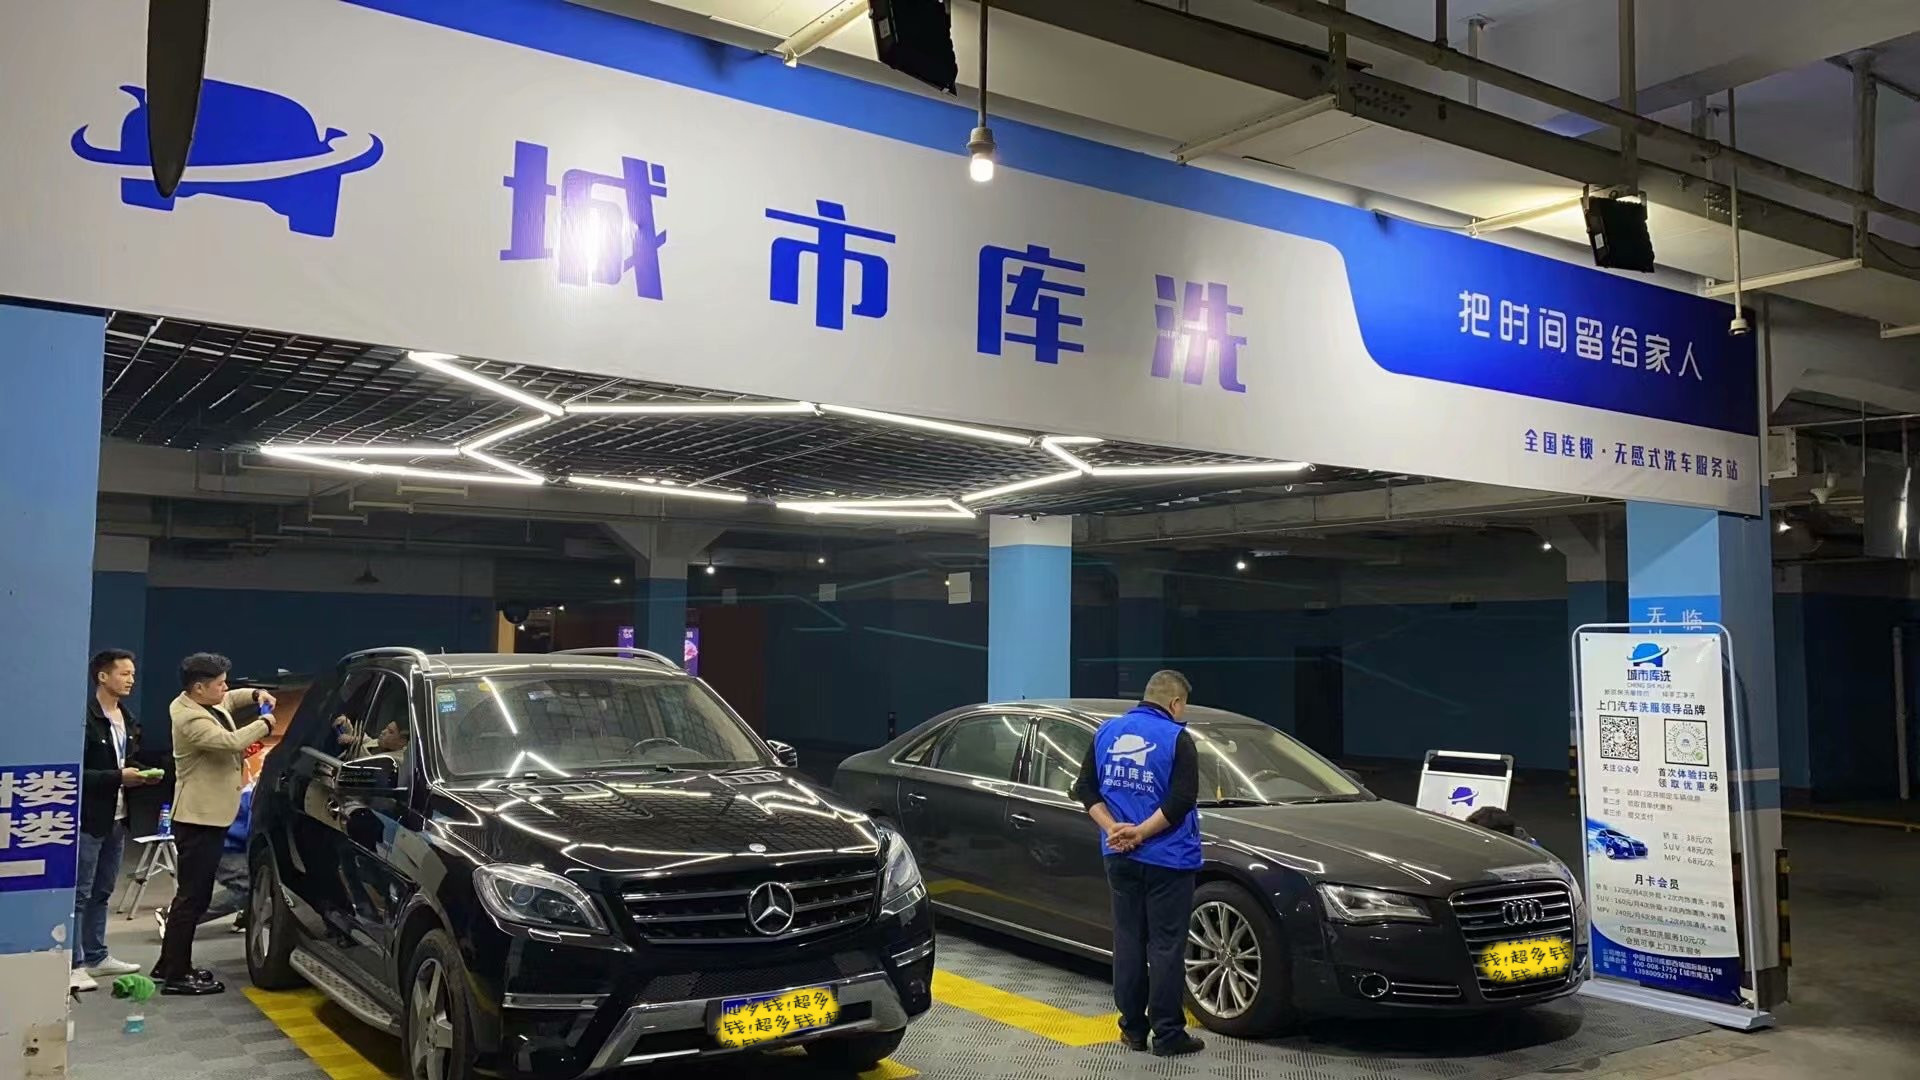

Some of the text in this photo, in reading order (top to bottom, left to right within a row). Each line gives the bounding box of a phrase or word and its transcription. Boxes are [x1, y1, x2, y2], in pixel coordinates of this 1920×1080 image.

[500, 140, 1248, 393] 城市库洗
[1459, 290, 1703, 381] 把时间留给家人
[1525, 429, 1739, 481] 全国连锁·无感式洗车服务站
[1627, 669, 1671, 682] 城市库洗
[1597, 700, 1706, 716] 上门汽车洗服领导品牌
[1602, 764, 1639, 774] 关注公众号
[1658, 768, 1718, 781] 首次体验扫码
[1658, 778, 1718, 792] 领取优惠券
[1635, 874, 1680, 890] 月卡会员
